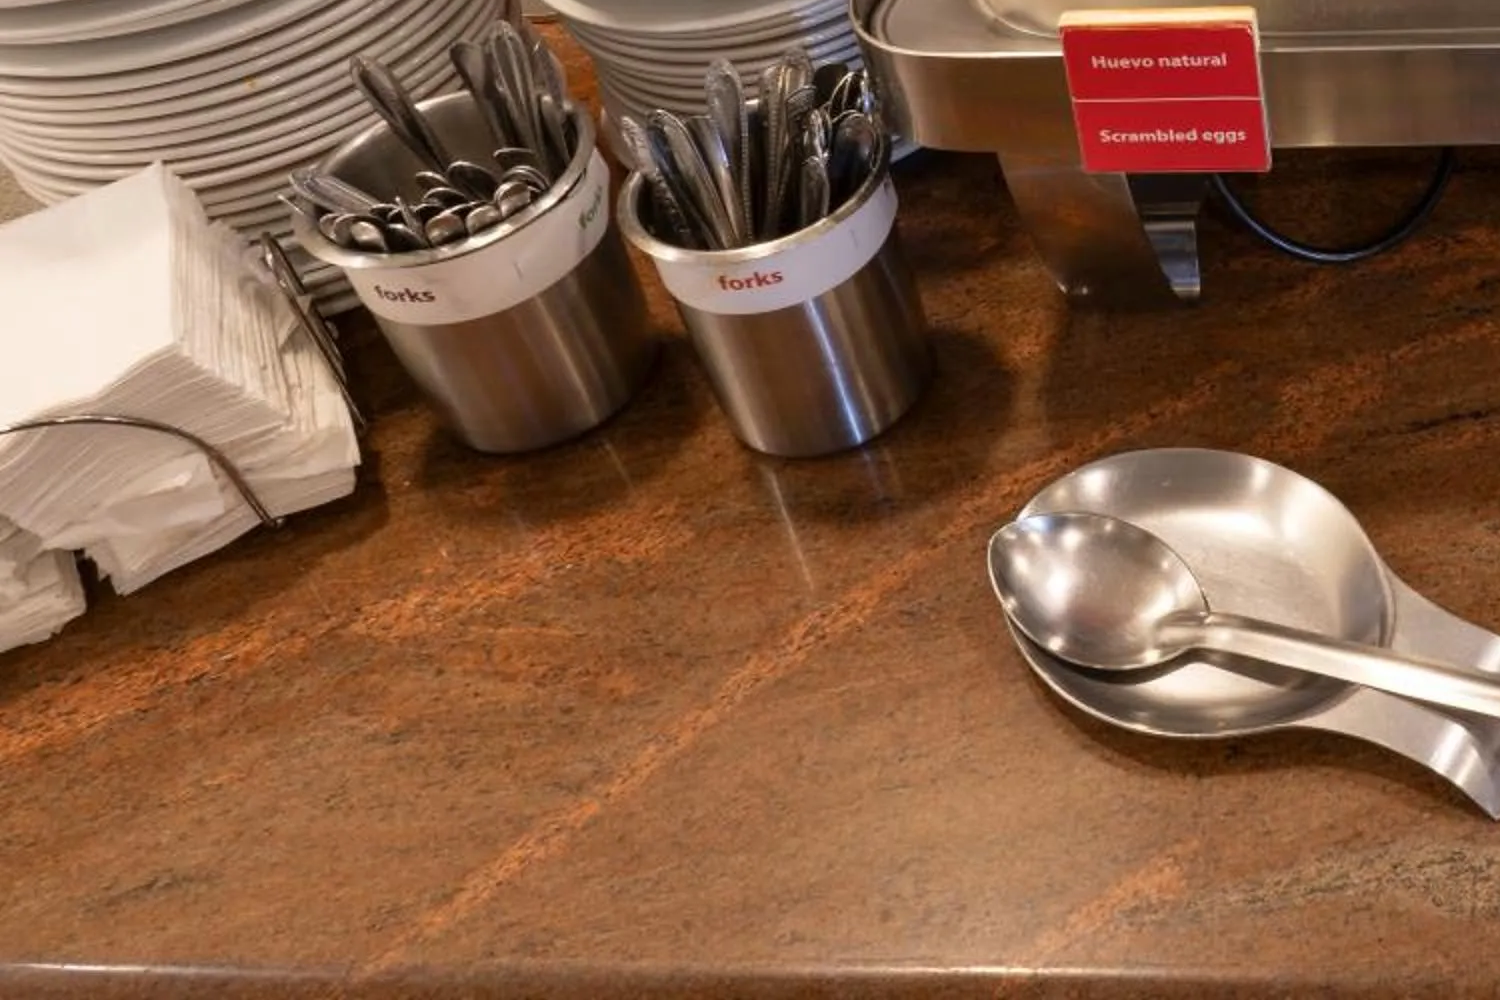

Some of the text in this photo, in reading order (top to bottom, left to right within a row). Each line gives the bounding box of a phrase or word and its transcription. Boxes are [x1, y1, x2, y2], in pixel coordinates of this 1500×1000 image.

[1090, 52, 1228, 70] Huevo natural
[1099, 128, 1248, 145] Scrambled eggs
[718, 271, 784, 291] forks
[373, 284, 436, 303] forks
